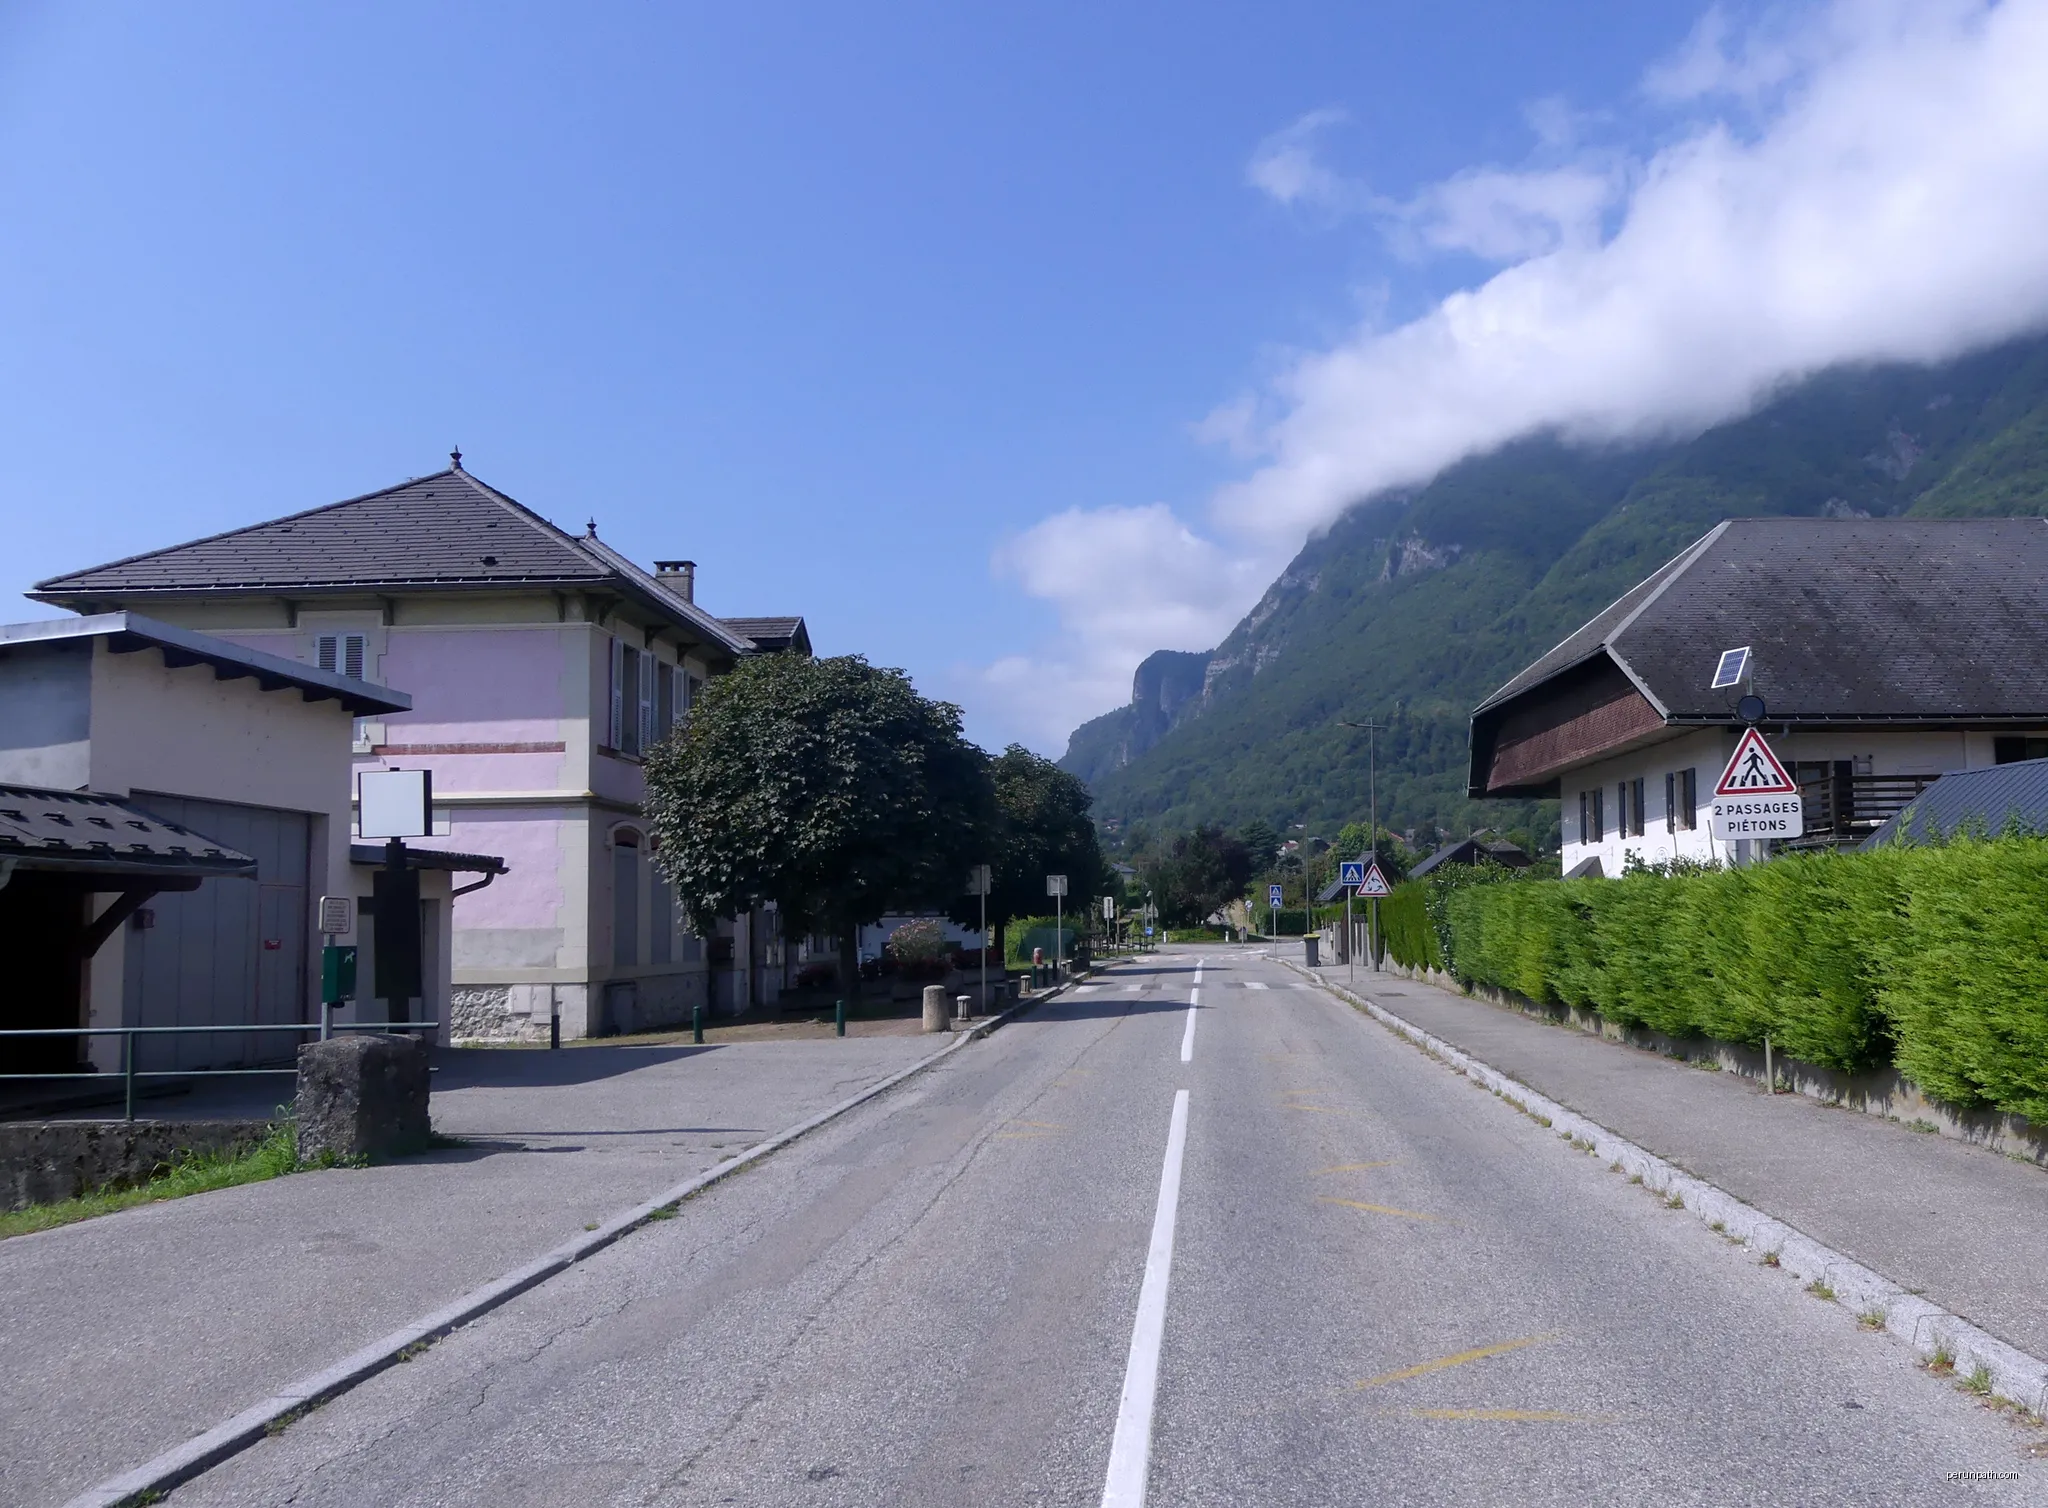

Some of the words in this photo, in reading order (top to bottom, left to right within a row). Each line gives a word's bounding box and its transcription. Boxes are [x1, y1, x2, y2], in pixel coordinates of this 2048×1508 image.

[1715, 805, 1722, 816] 2
[1727, 802, 1799, 815] PASSAGES
[1728, 818, 1787, 832] PIÉTONS
